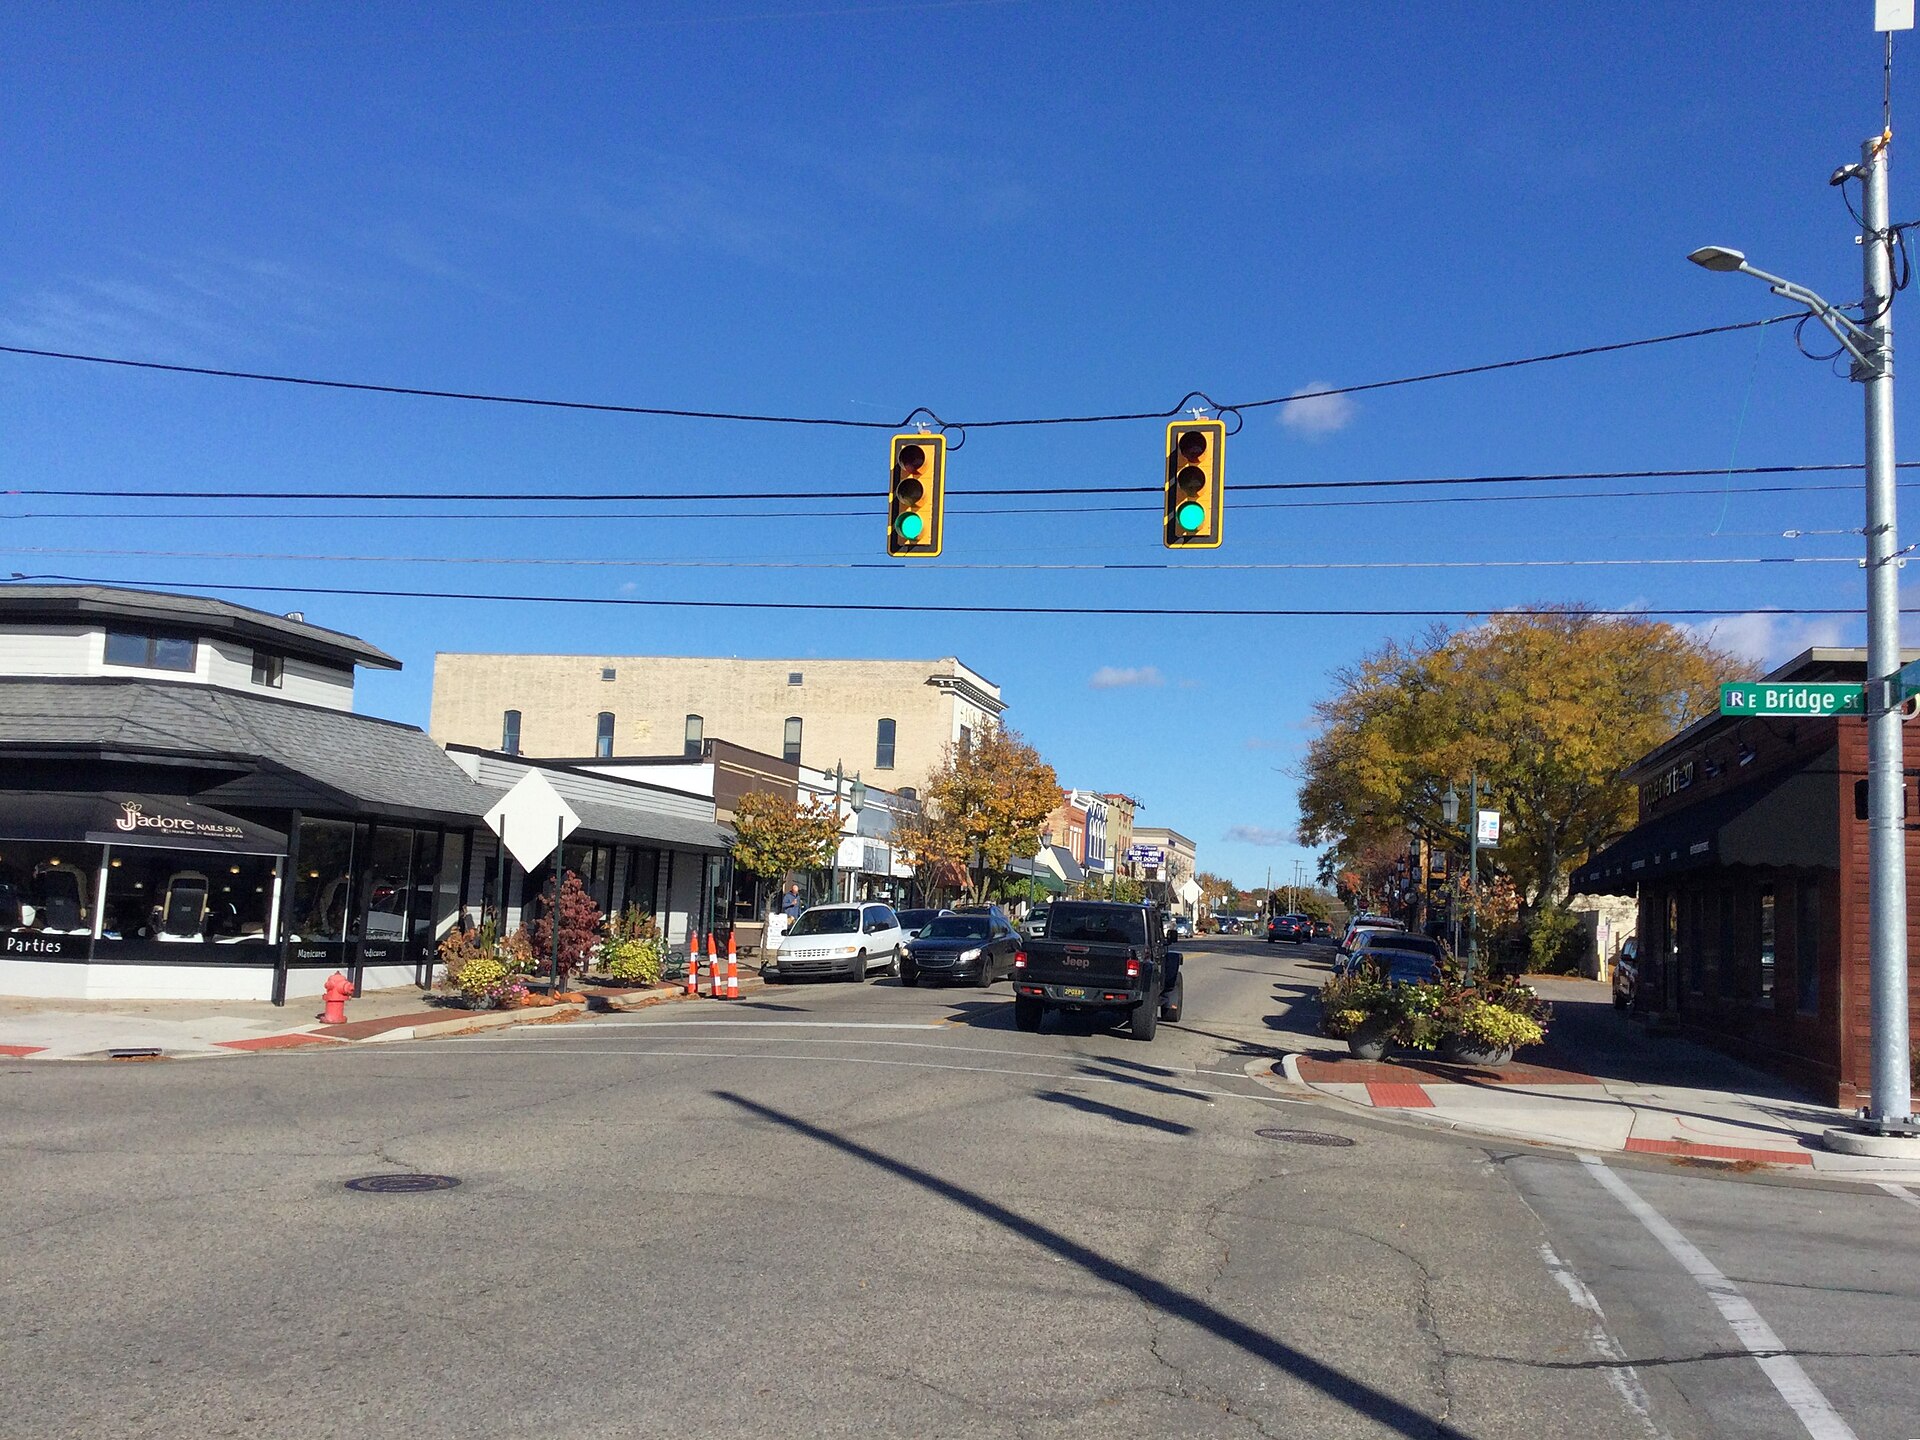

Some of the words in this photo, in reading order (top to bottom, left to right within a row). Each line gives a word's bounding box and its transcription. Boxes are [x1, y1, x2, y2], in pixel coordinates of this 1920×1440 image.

[1748, 694, 1757, 708] E
[1765, 688, 1835, 713] Bridge
[1843, 694, 1859, 709] St
[196, 823, 224, 832] NAILS
[224, 825, 243, 834] SPA
[7, 937, 61, 952] Parties
[297, 948, 327, 958] Manicures
[1061, 956, 1090, 969] Jeep
